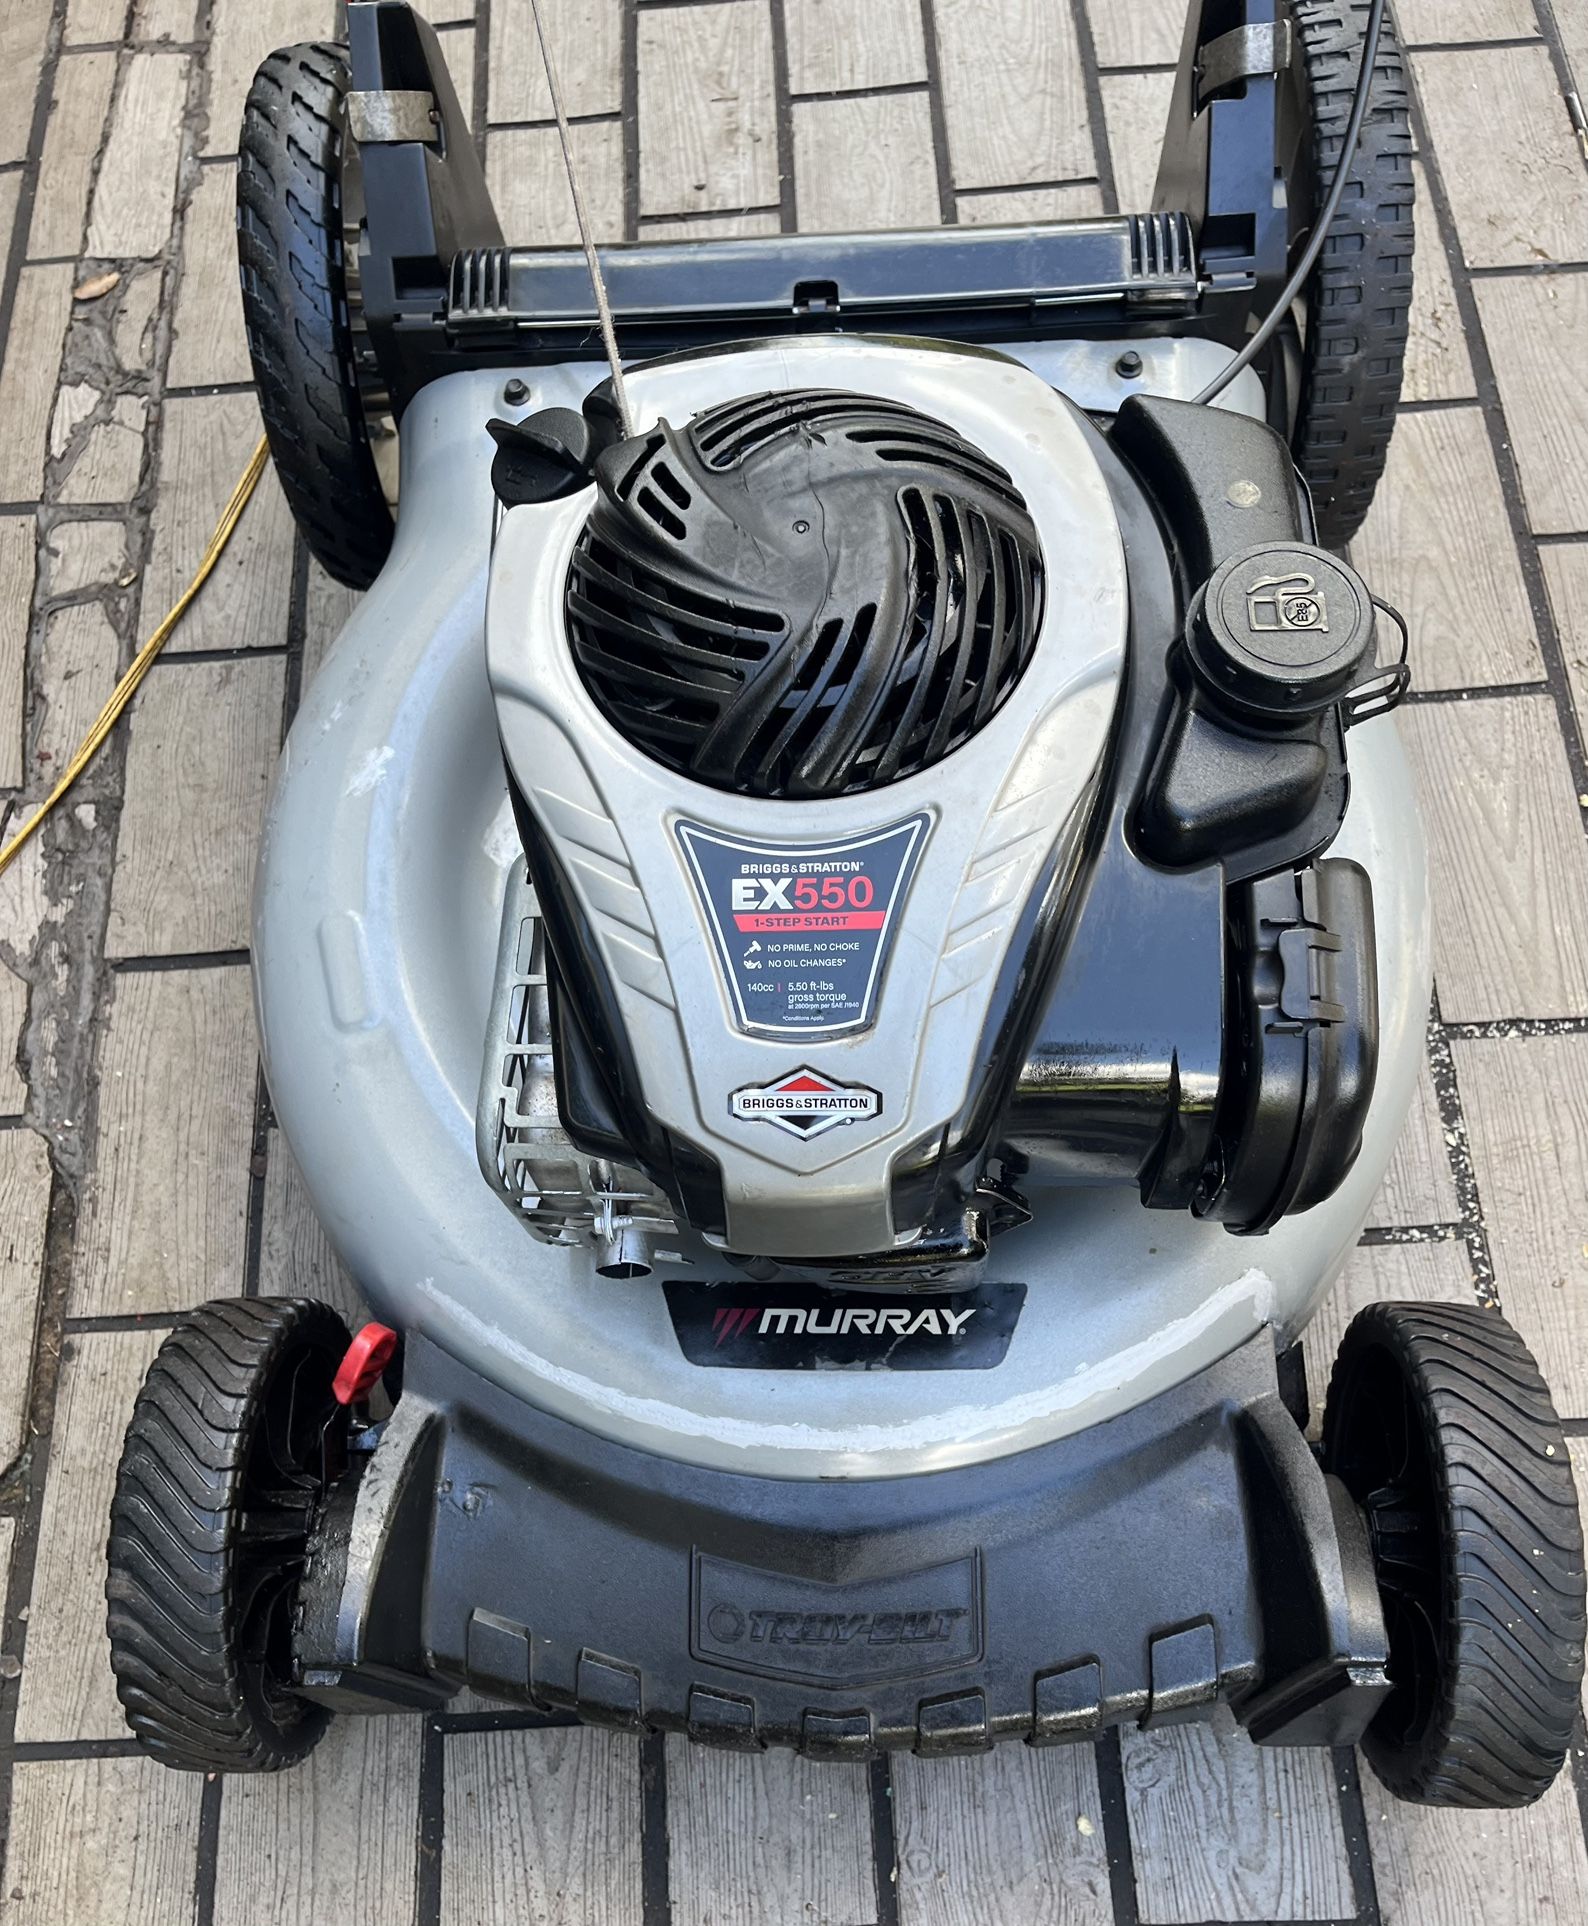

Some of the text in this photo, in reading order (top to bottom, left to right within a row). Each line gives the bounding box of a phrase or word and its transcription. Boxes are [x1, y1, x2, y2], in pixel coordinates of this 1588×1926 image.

[1296, 602, 1309, 622] E85
[731, 876, 874, 910] EX550
[754, 916, 848, 927] 1-STEP START
[767, 942, 860, 952] NO PRIME, NO CHOKE
[768, 960, 782, 968] NO
[783, 959, 798, 968] OIL
[747, 981, 834, 992] 140cc 5.50 ft-lbs
[788, 992, 847, 1004] gross torque
[743, 1098, 868, 1109] BRIGGS&STRATTON
[758, 1308, 977, 1335] MURRAY
